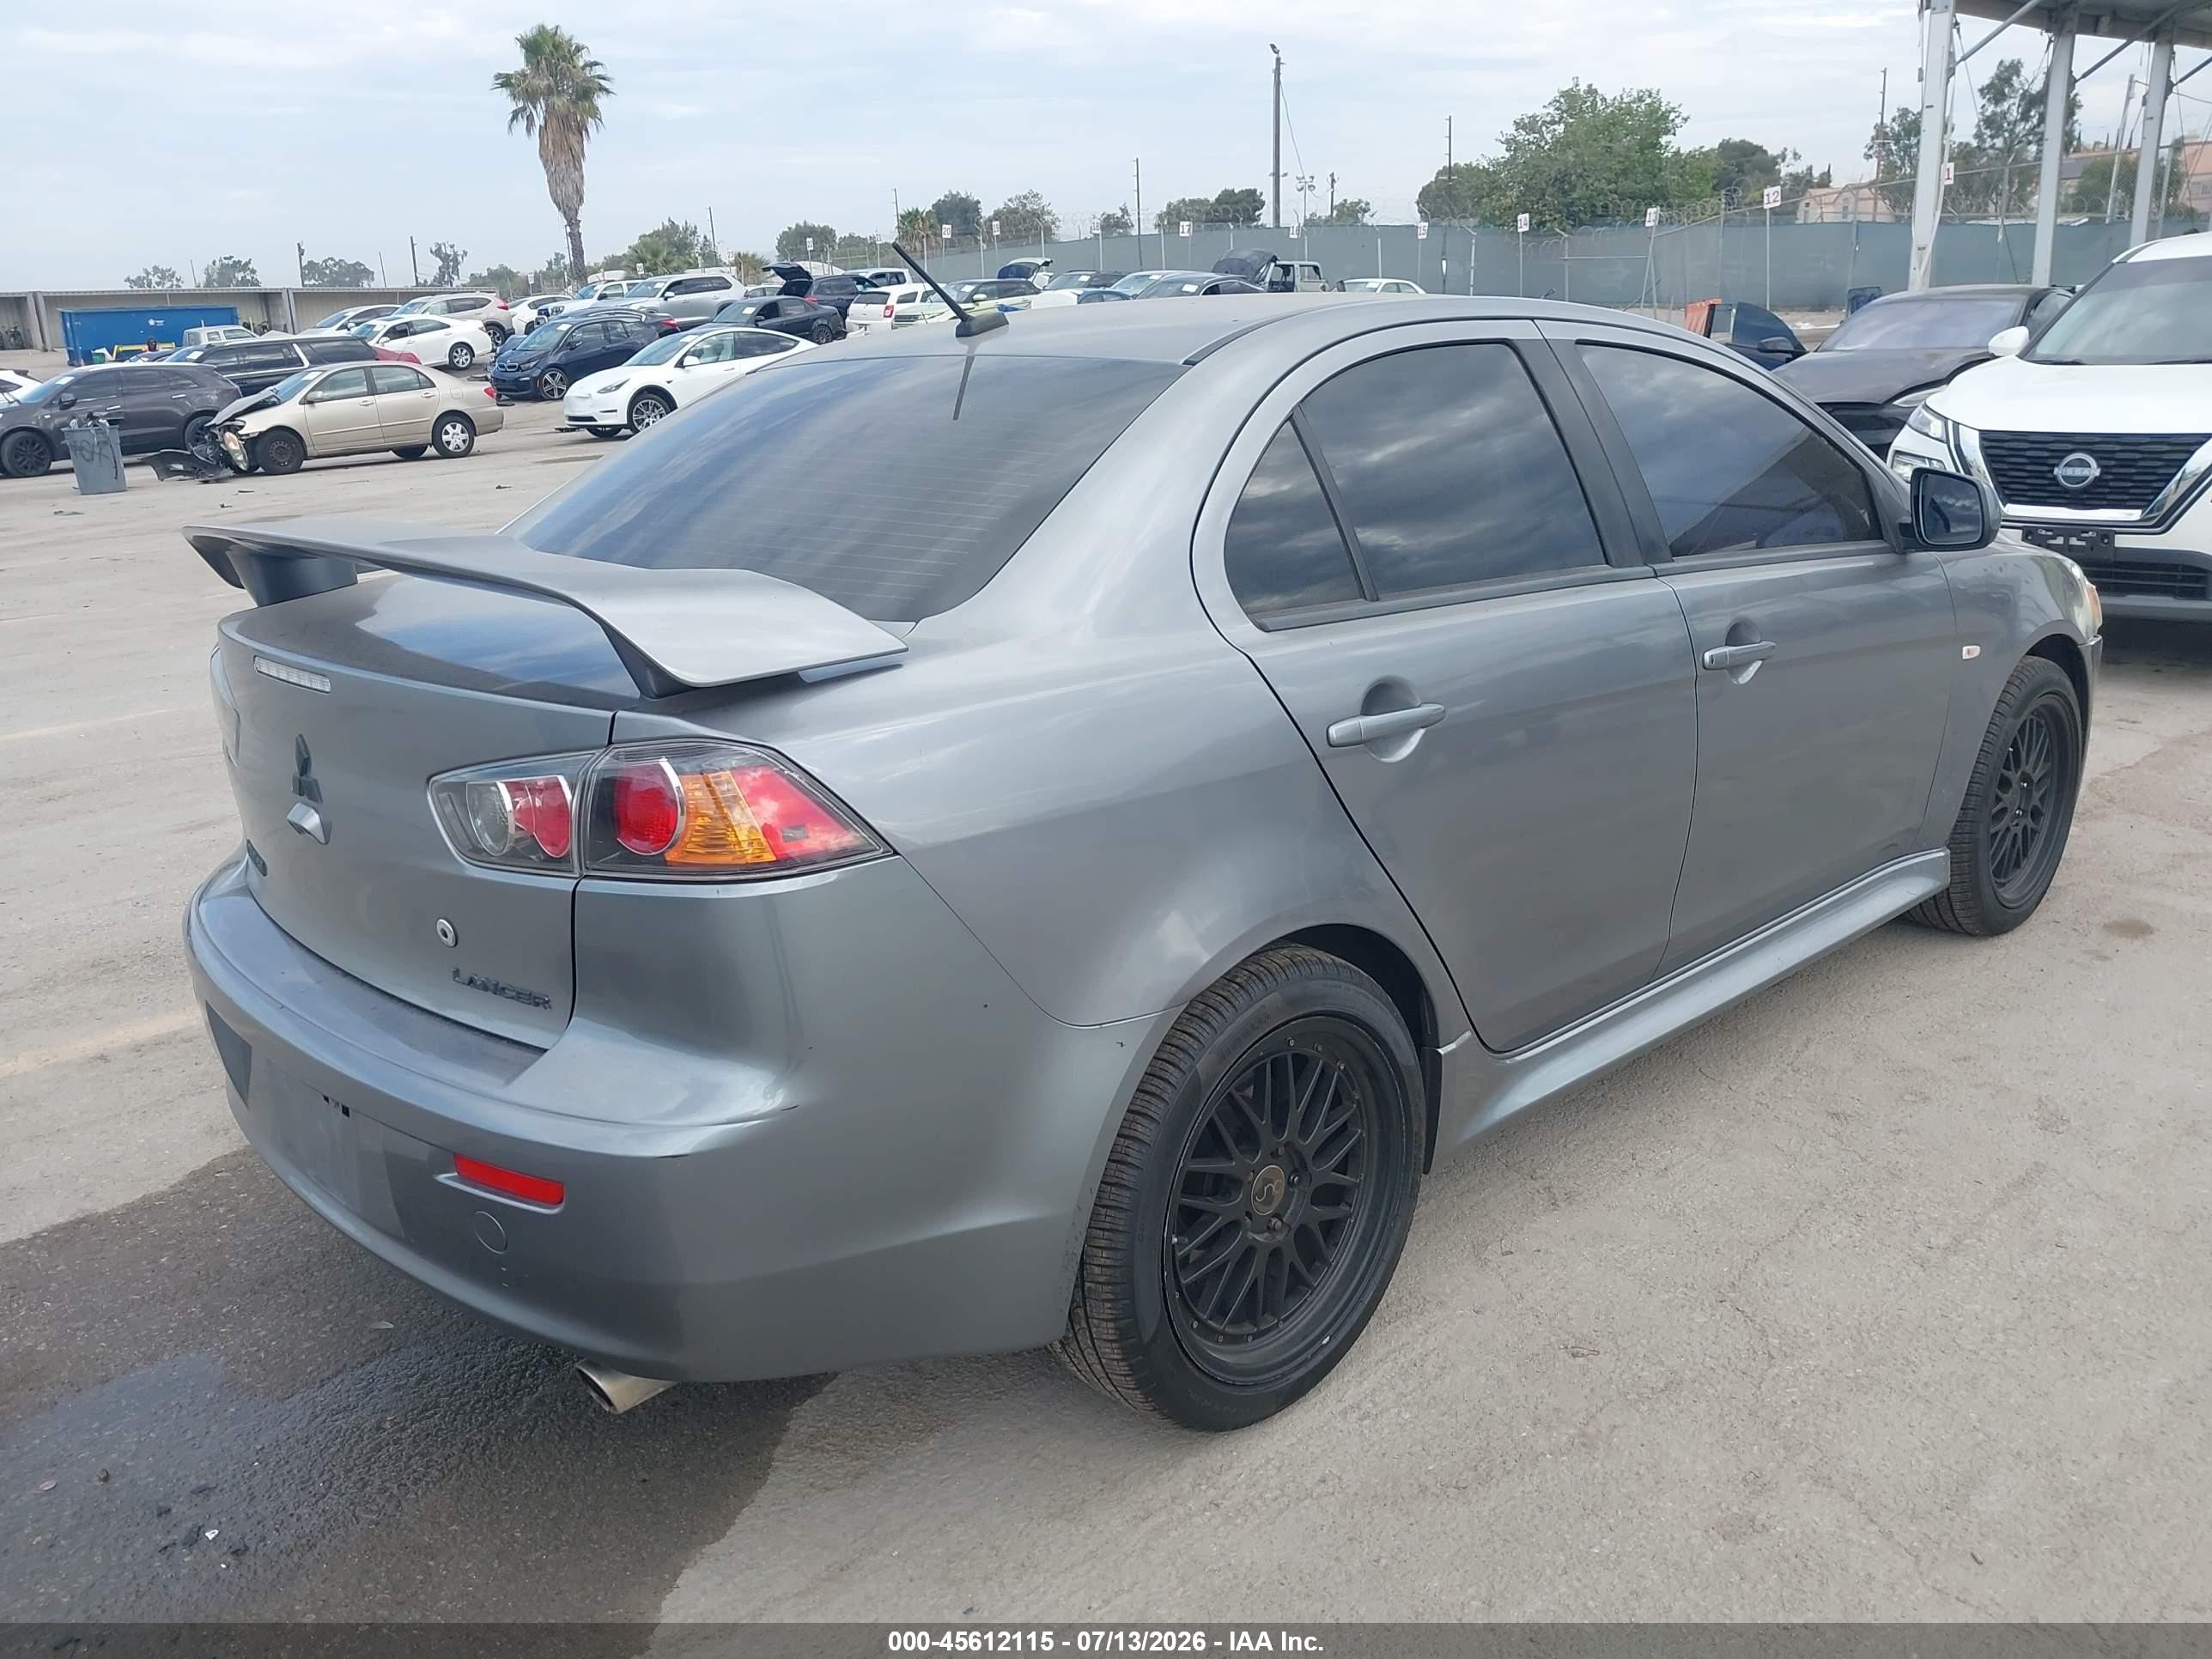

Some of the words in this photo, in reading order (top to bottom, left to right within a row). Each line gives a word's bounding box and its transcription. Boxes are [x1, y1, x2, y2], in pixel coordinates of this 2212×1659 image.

[1765, 191, 1779, 205] 12
[1519, 216, 1528, 228] 14
[943, 227, 951, 235] 20
[1181, 224, 1190, 234] 17
[1419, 226, 1427, 235] 15
[2053, 466, 2101, 477] NISSAN
[451, 967, 552, 1011] LANCER
